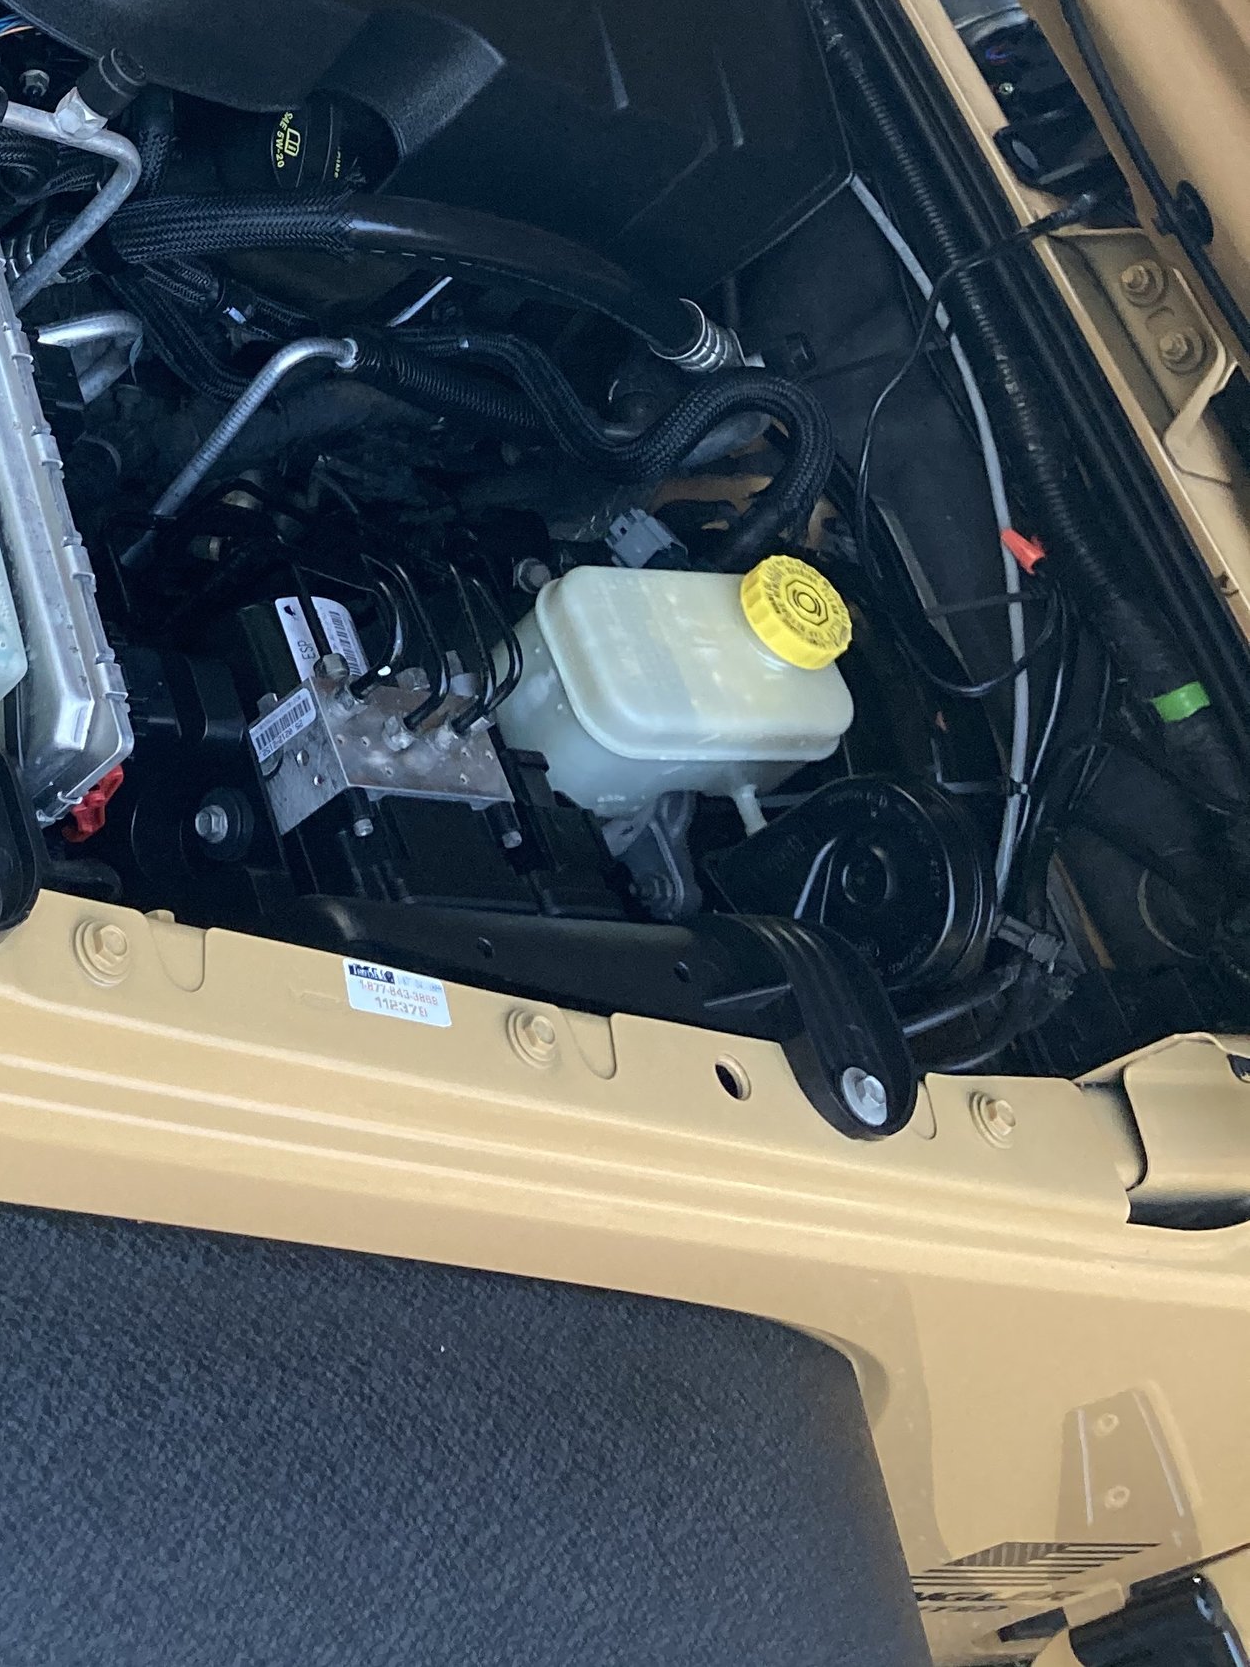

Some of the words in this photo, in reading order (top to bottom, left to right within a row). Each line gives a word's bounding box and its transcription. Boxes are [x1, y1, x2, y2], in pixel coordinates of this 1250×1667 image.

[279, 111, 294, 131] SAE
[275, 130, 285, 168] 5W-20
[297, 640, 316, 660] ESP
